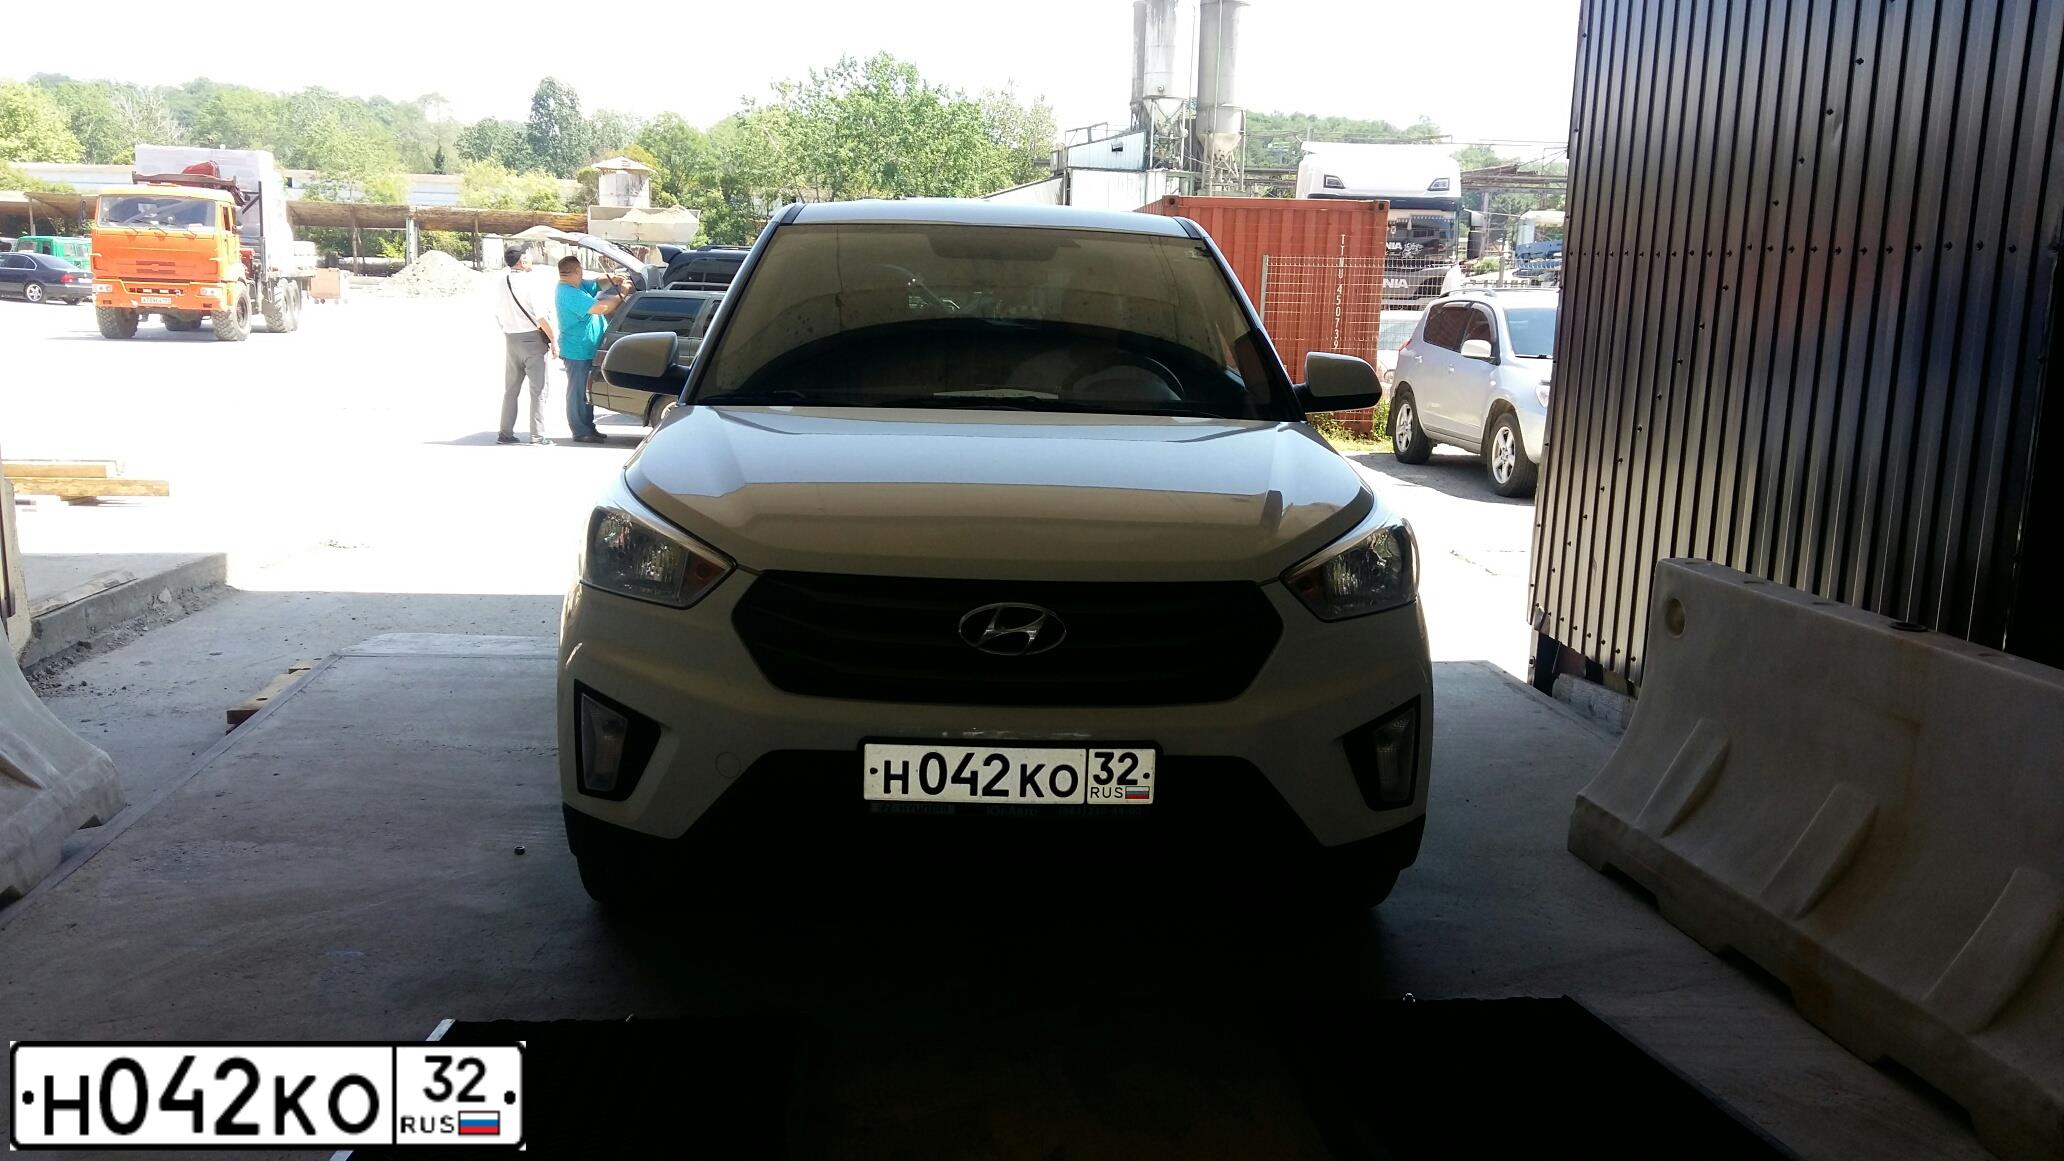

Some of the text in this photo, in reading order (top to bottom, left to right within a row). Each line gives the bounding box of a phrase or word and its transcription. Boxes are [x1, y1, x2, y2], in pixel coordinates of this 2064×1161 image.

[1382, 278, 1408, 289] NIA
[1333, 284, 1343, 350] 450739
[1093, 752, 1138, 785] 32
[1090, 786, 1123, 799] RUS
